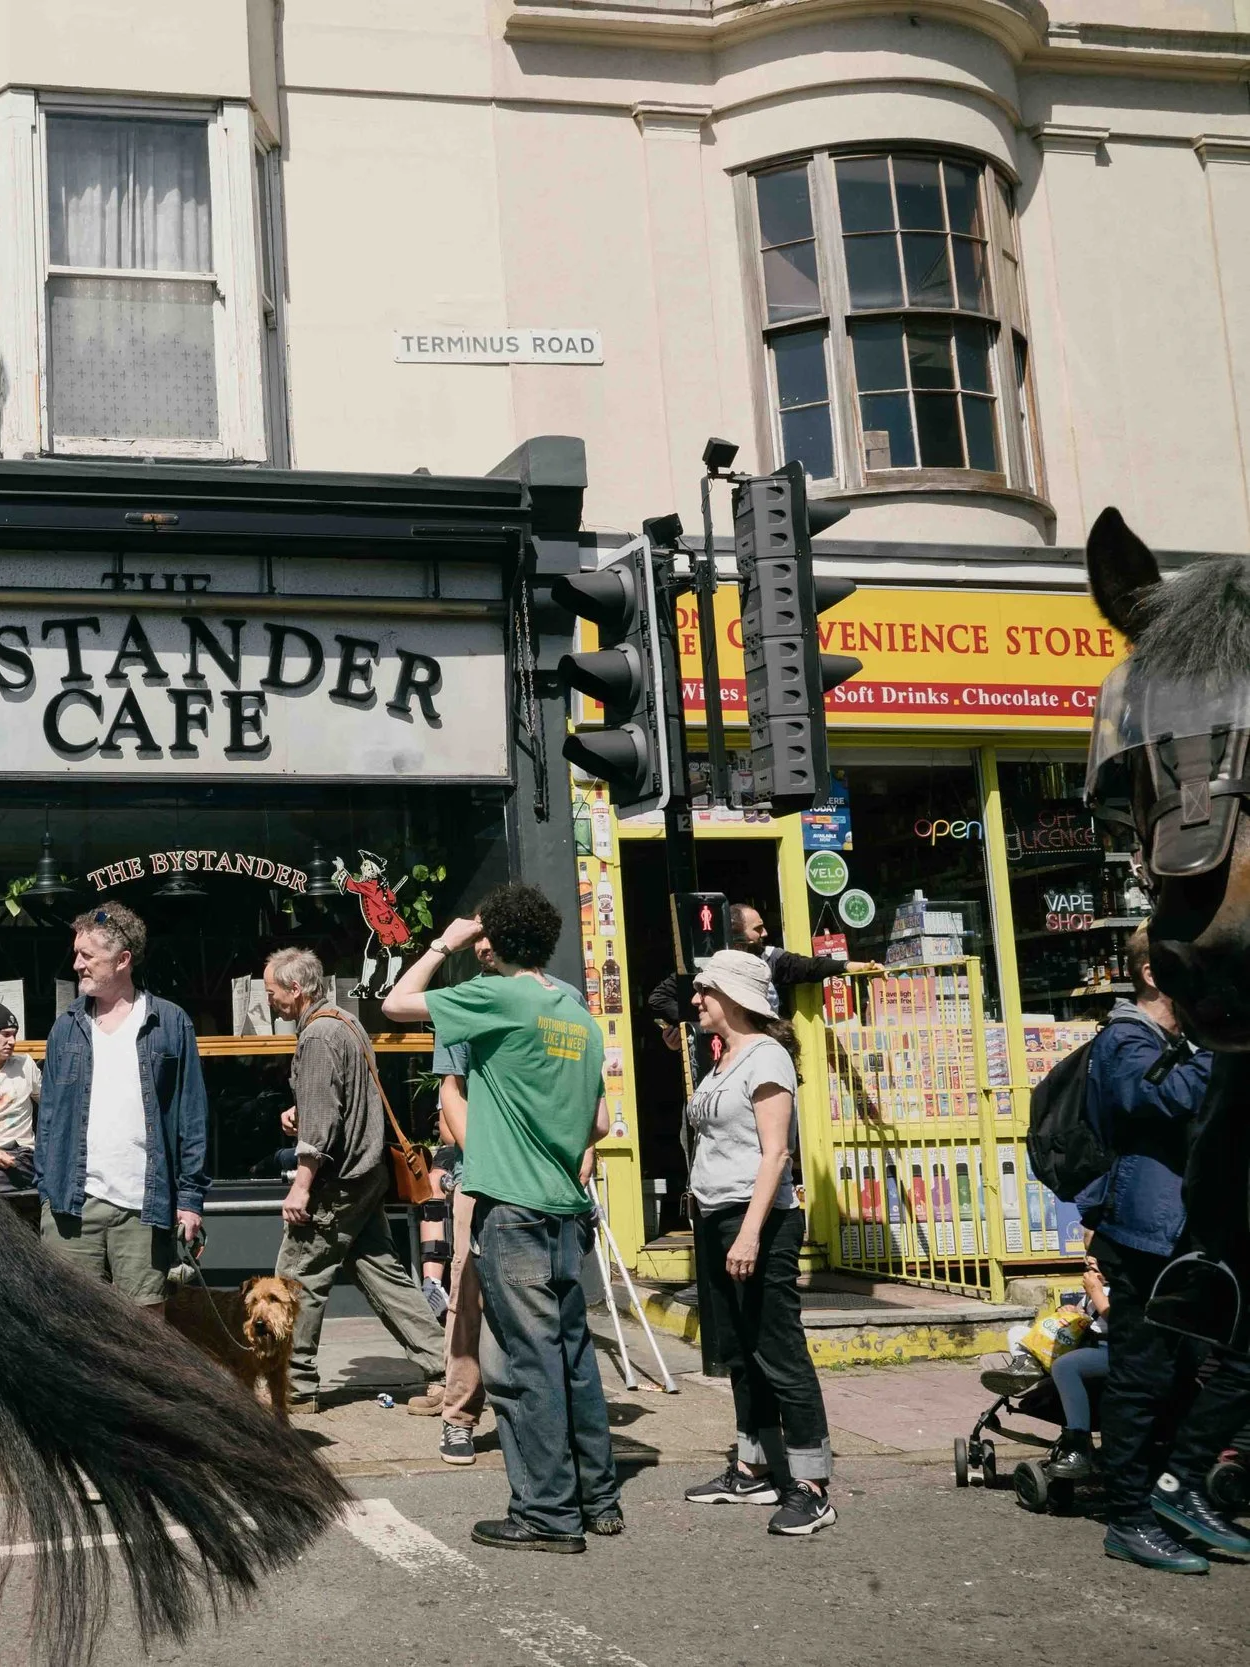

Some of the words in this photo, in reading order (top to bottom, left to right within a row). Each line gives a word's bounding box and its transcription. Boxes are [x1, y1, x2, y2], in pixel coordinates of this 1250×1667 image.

[401, 335, 520, 353] TERMINUS
[532, 336, 595, 354] ROAD
[101, 572, 212, 592] THE
[726, 618, 989, 655] CVENIENCE
[1006, 625, 1115, 658] STORE
[681, 683, 740, 702] Wies
[833, 685, 875, 704] Soft
[881, 686, 950, 705] Drinks
[961, 687, 1060, 707] Chocolate
[43, 687, 271, 754] CAFE
[825, 796, 845, 805] ERE
[682, 815, 691, 829] 2
[1038, 811, 1077, 828] OFF
[1021, 827, 1095, 849] LICENCE
[87, 857, 145, 892] THE
[149, 850, 308, 894] BYSTANDER
[809, 867, 845, 879] VELO
[1044, 894, 1095, 912] VAPE
[1045, 912, 1095, 931] SHOP
[879, 990, 899, 998] Tave
[543, 1031, 559, 1046] LIKE
[560, 1034, 566, 1047] A
[566, 1036, 587, 1051] WEED
